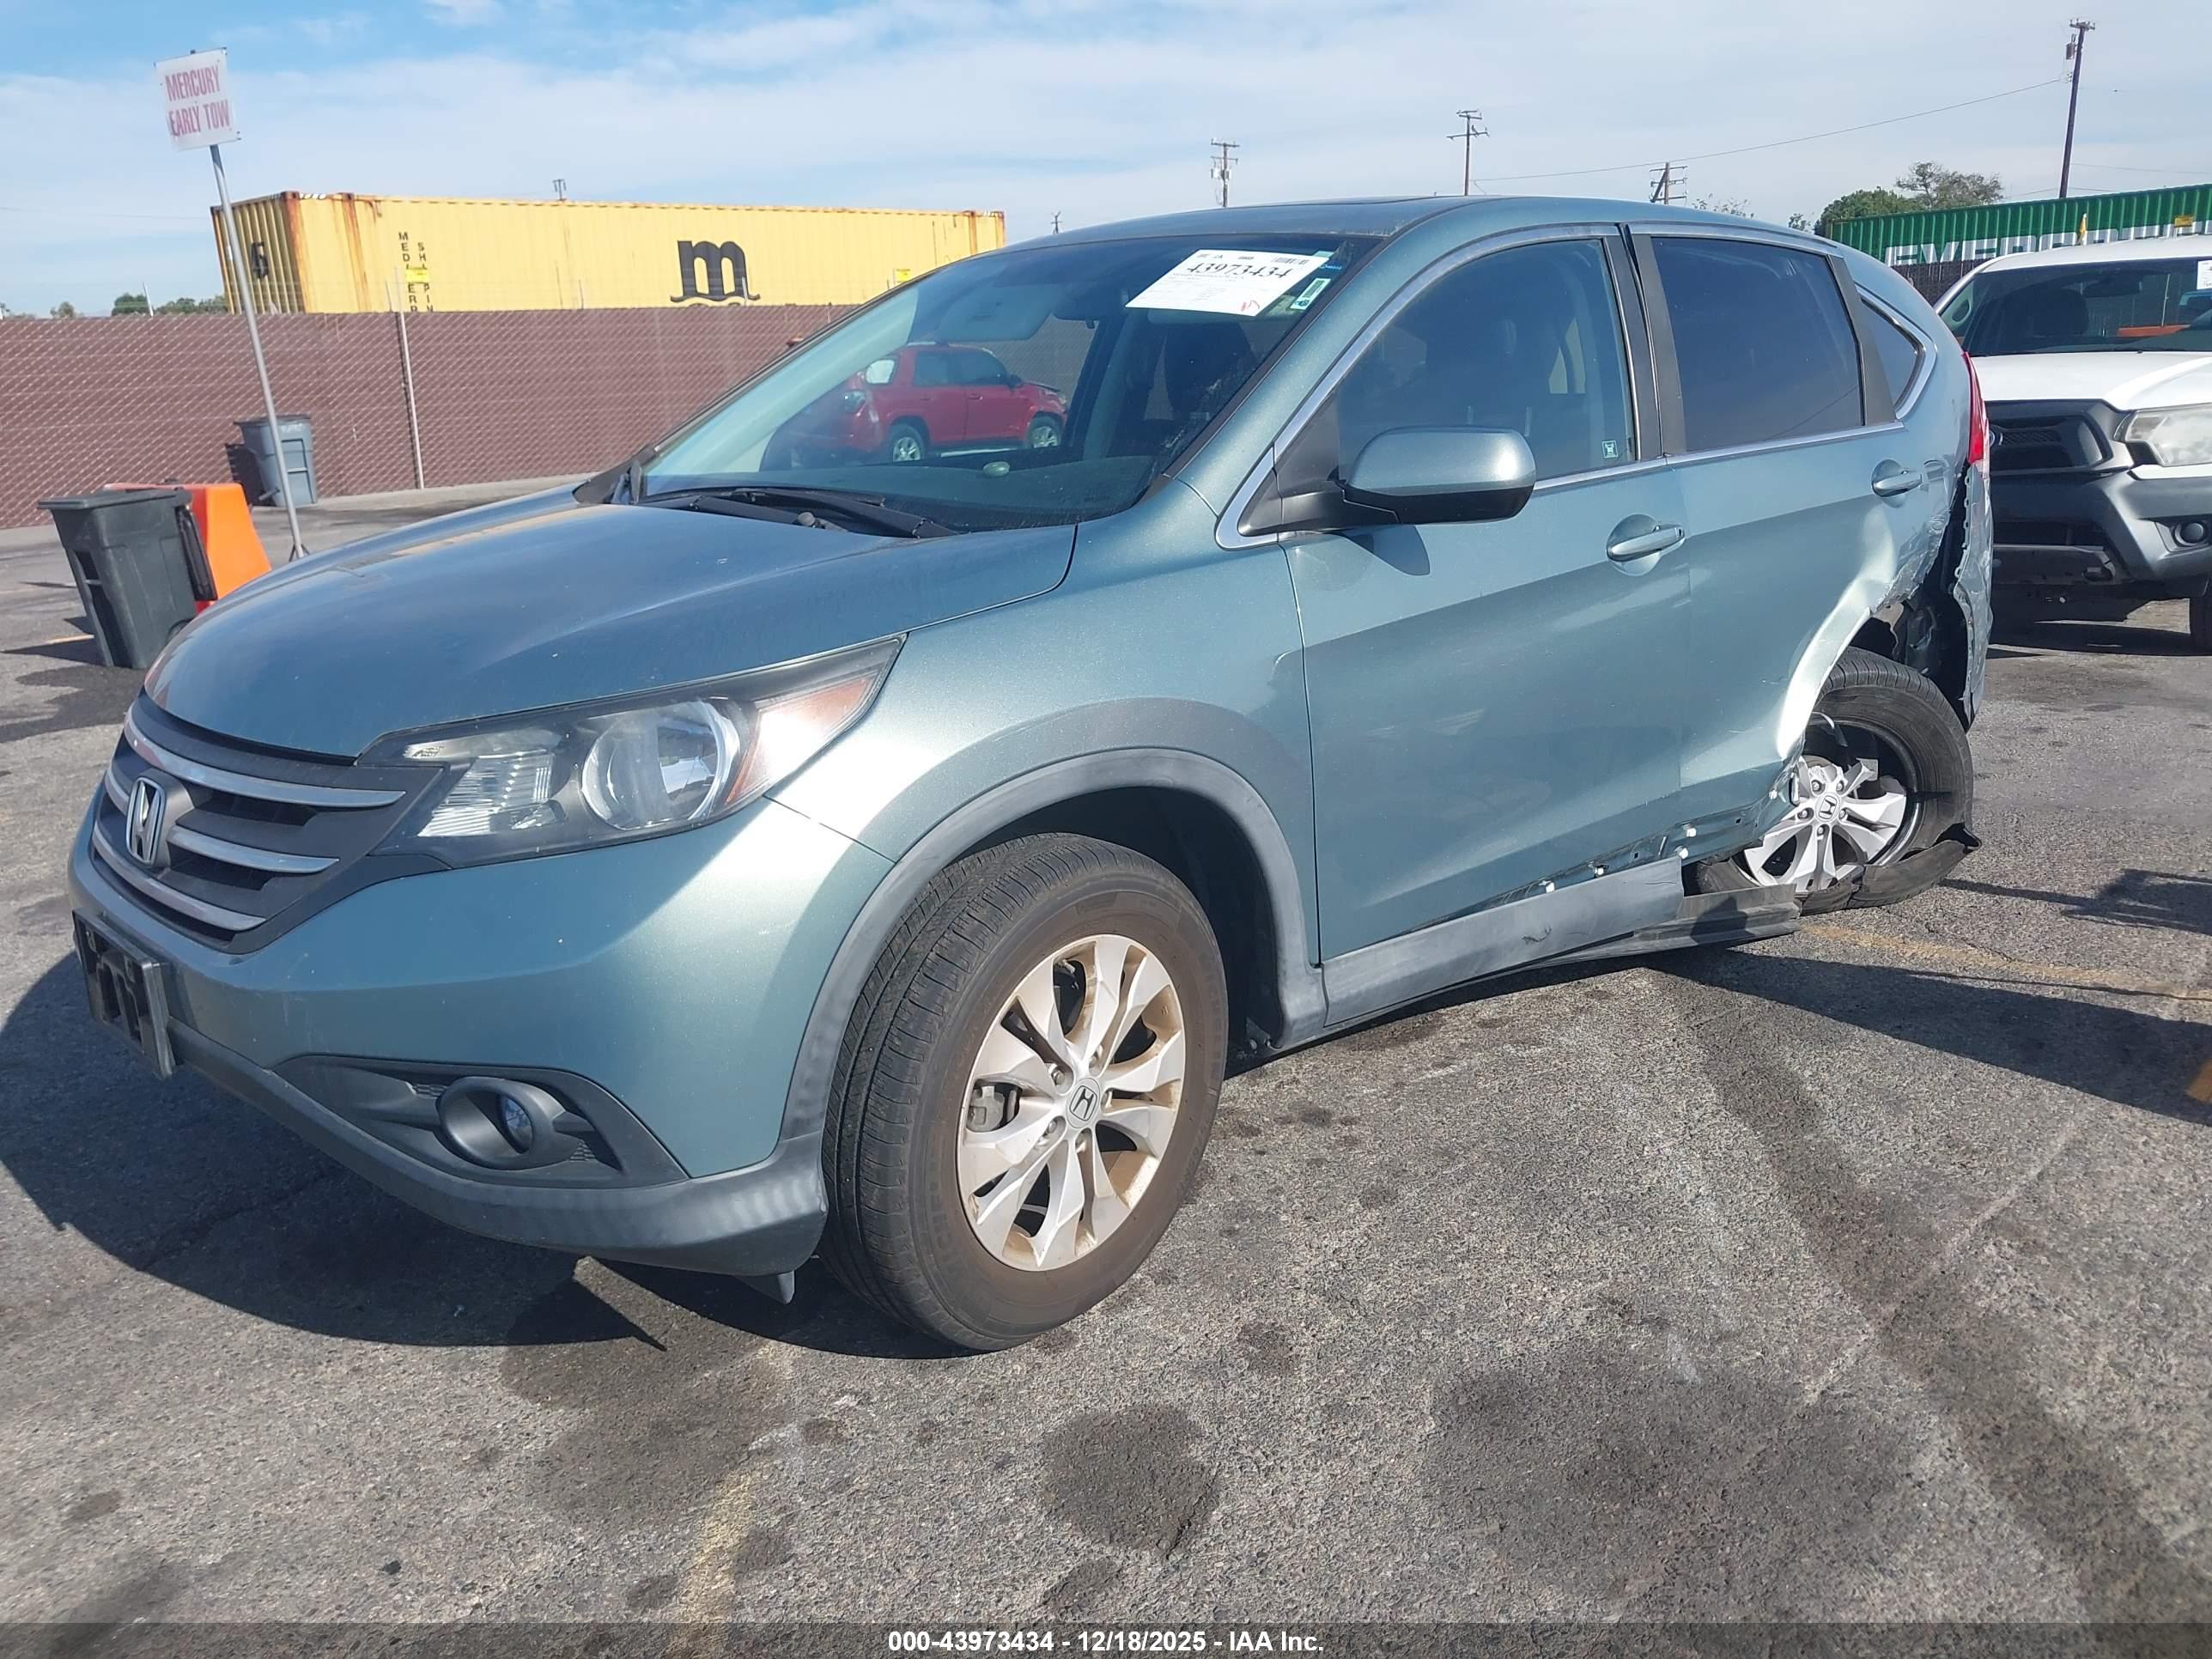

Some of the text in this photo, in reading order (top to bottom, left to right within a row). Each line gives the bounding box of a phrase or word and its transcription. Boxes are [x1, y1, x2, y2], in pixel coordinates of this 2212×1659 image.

[166, 65, 220, 101] MERCURY
[169, 99, 230, 137] EARLY TOW
[1187, 263, 1293, 278] 43973434
